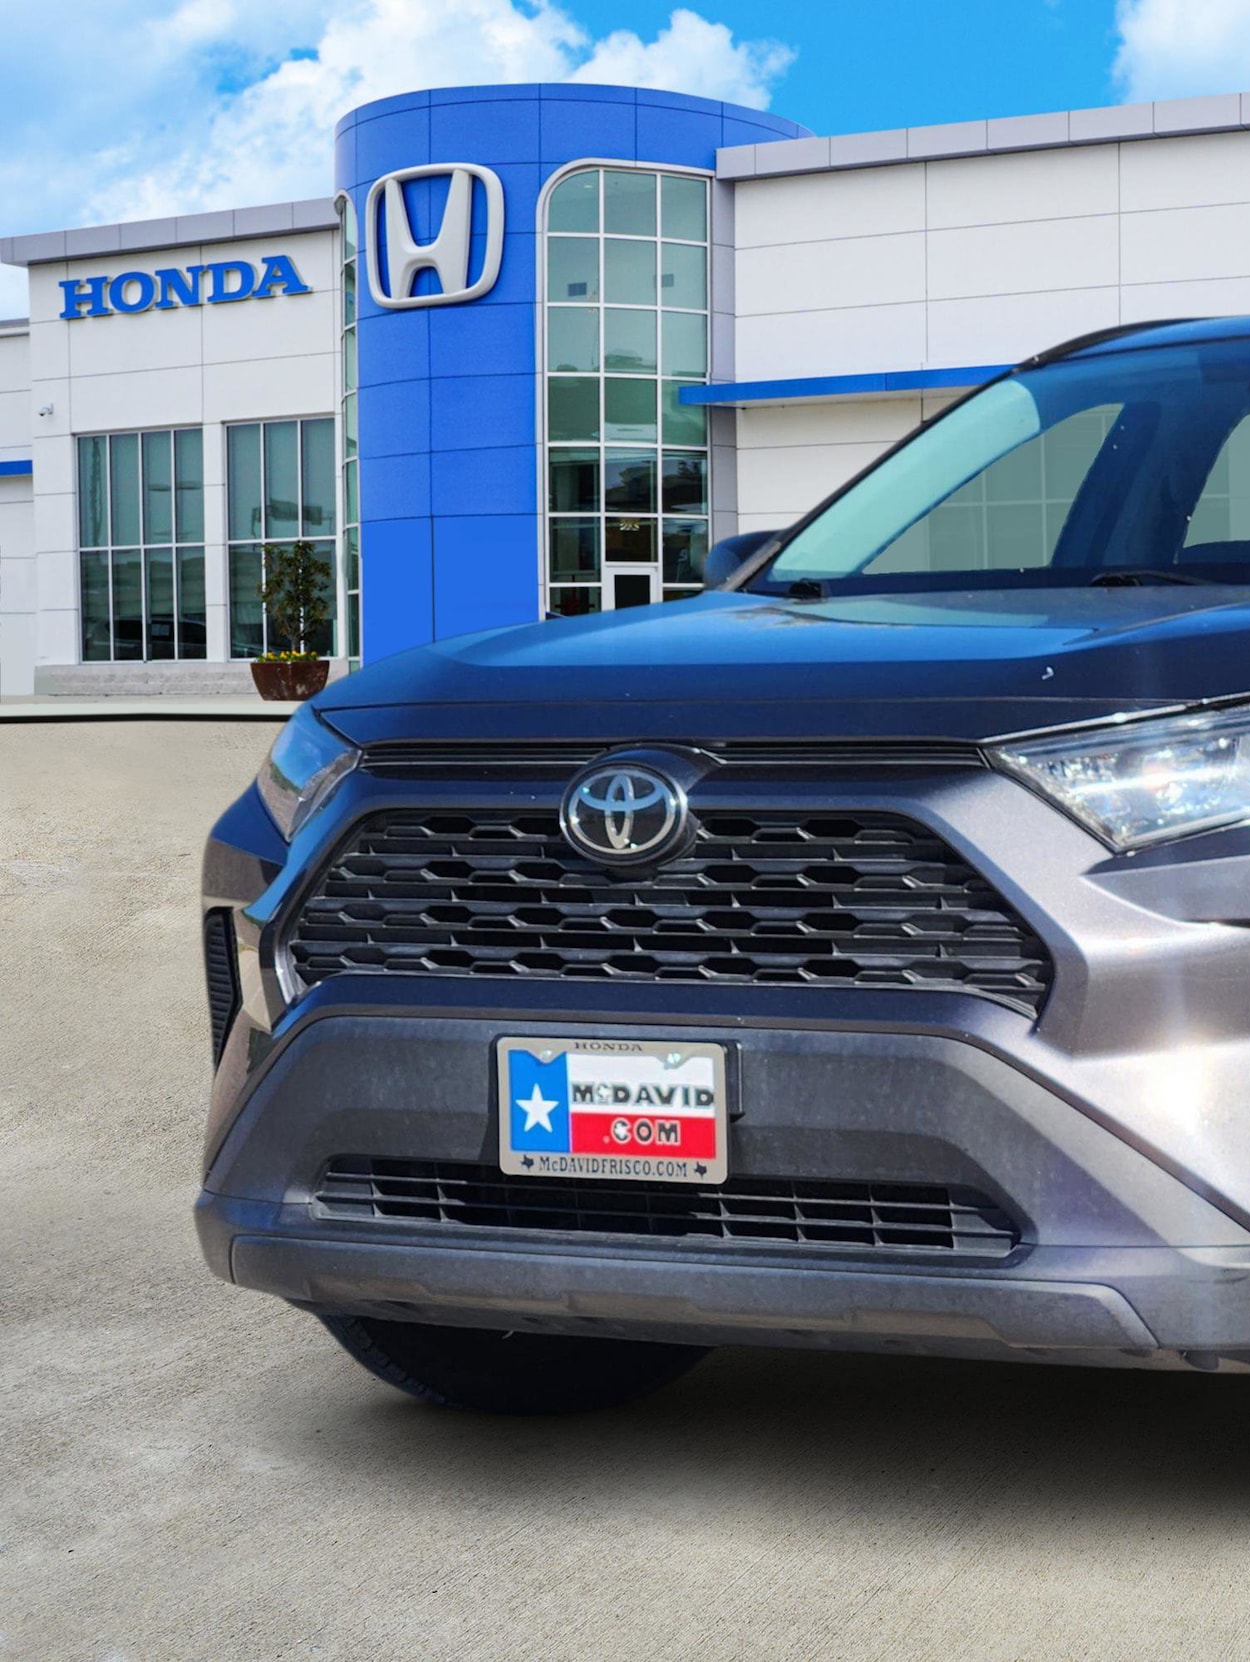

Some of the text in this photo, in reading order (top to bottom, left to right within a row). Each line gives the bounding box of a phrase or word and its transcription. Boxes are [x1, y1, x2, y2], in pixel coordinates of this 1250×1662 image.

[58, 255, 312, 320] HONDA
[573, 1041, 644, 1052] HONDA
[602, 1116, 682, 1146] .COM
[538, 1155, 688, 1178] McDAVIDFRISCO.COM
